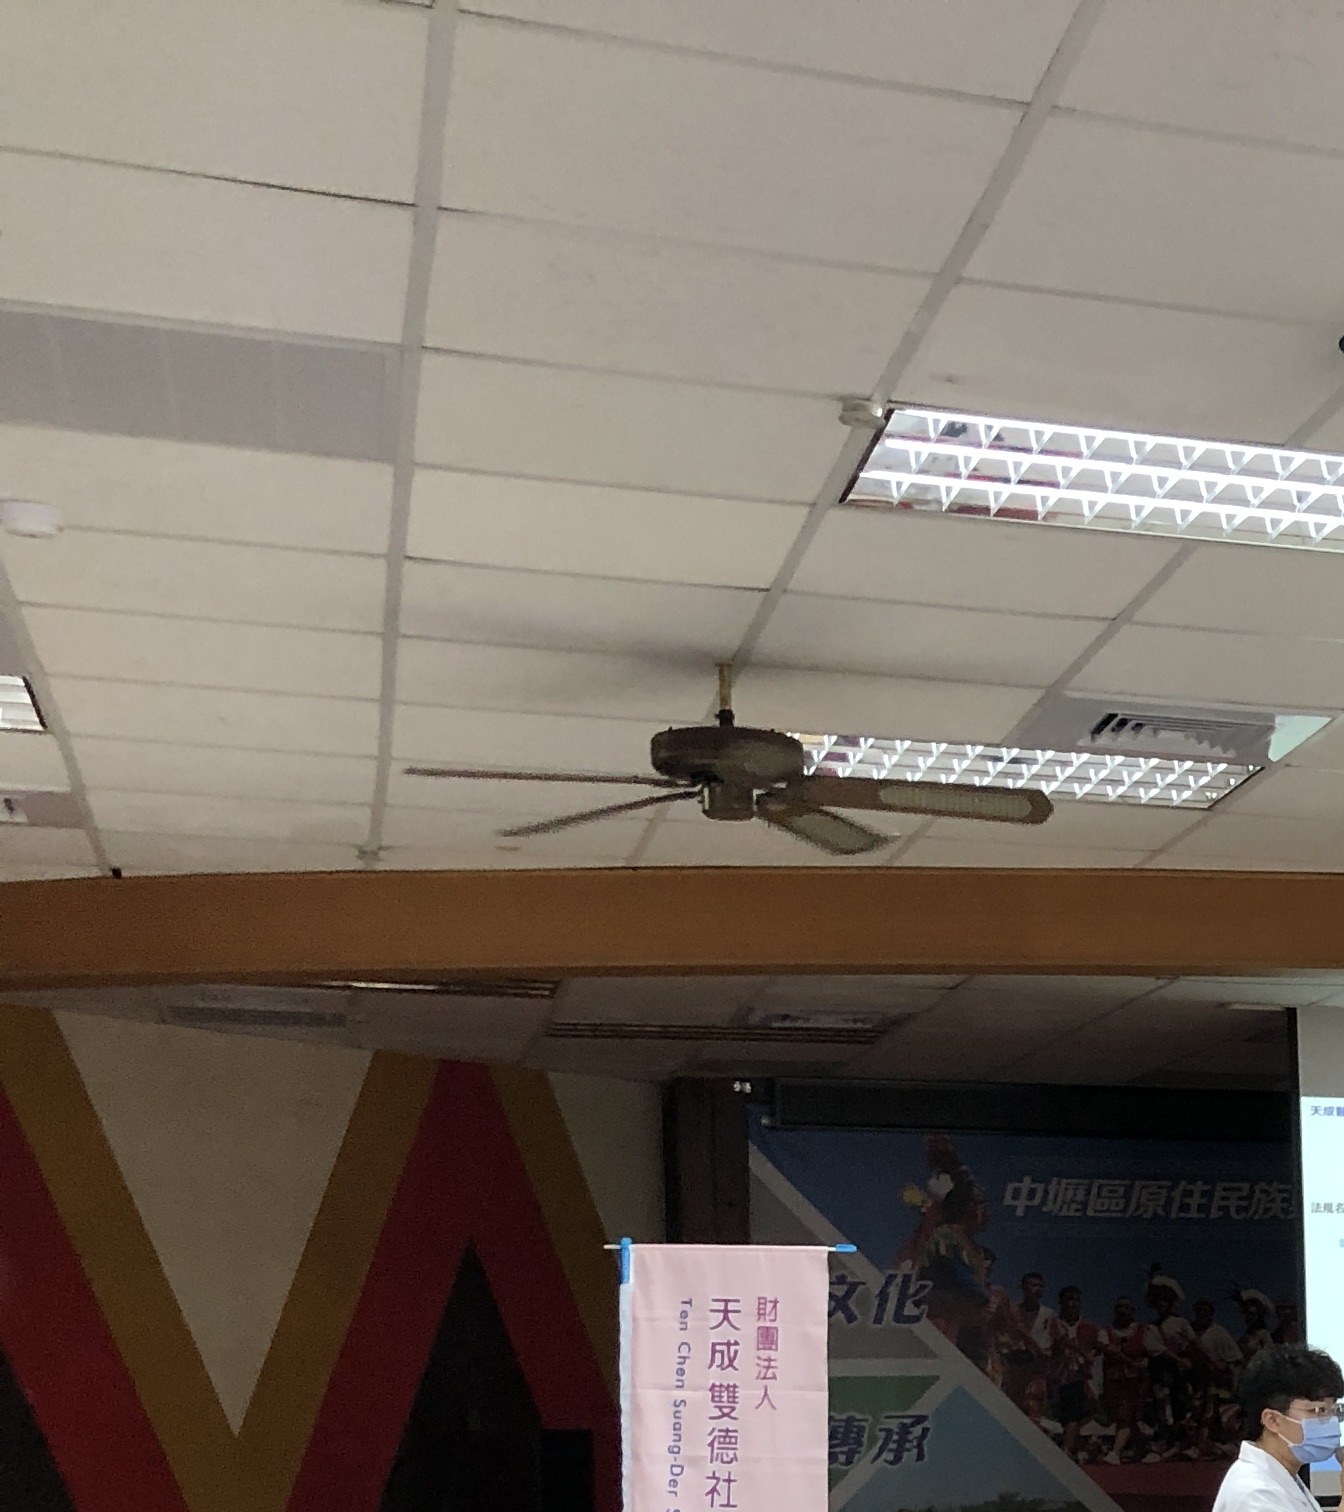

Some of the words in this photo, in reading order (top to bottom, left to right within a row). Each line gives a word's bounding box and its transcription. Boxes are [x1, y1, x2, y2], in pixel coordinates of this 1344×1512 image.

[1003, 1175, 1300, 1221] 中壢區原住民族
[680, 1298, 692, 1331] Ten
[828, 1270, 933, 1326] 文化
[676, 1343, 691, 1389] Chen
[754, 1296, 779, 1411] 財團法人
[666, 1400, 687, 1497] Suang-Der
